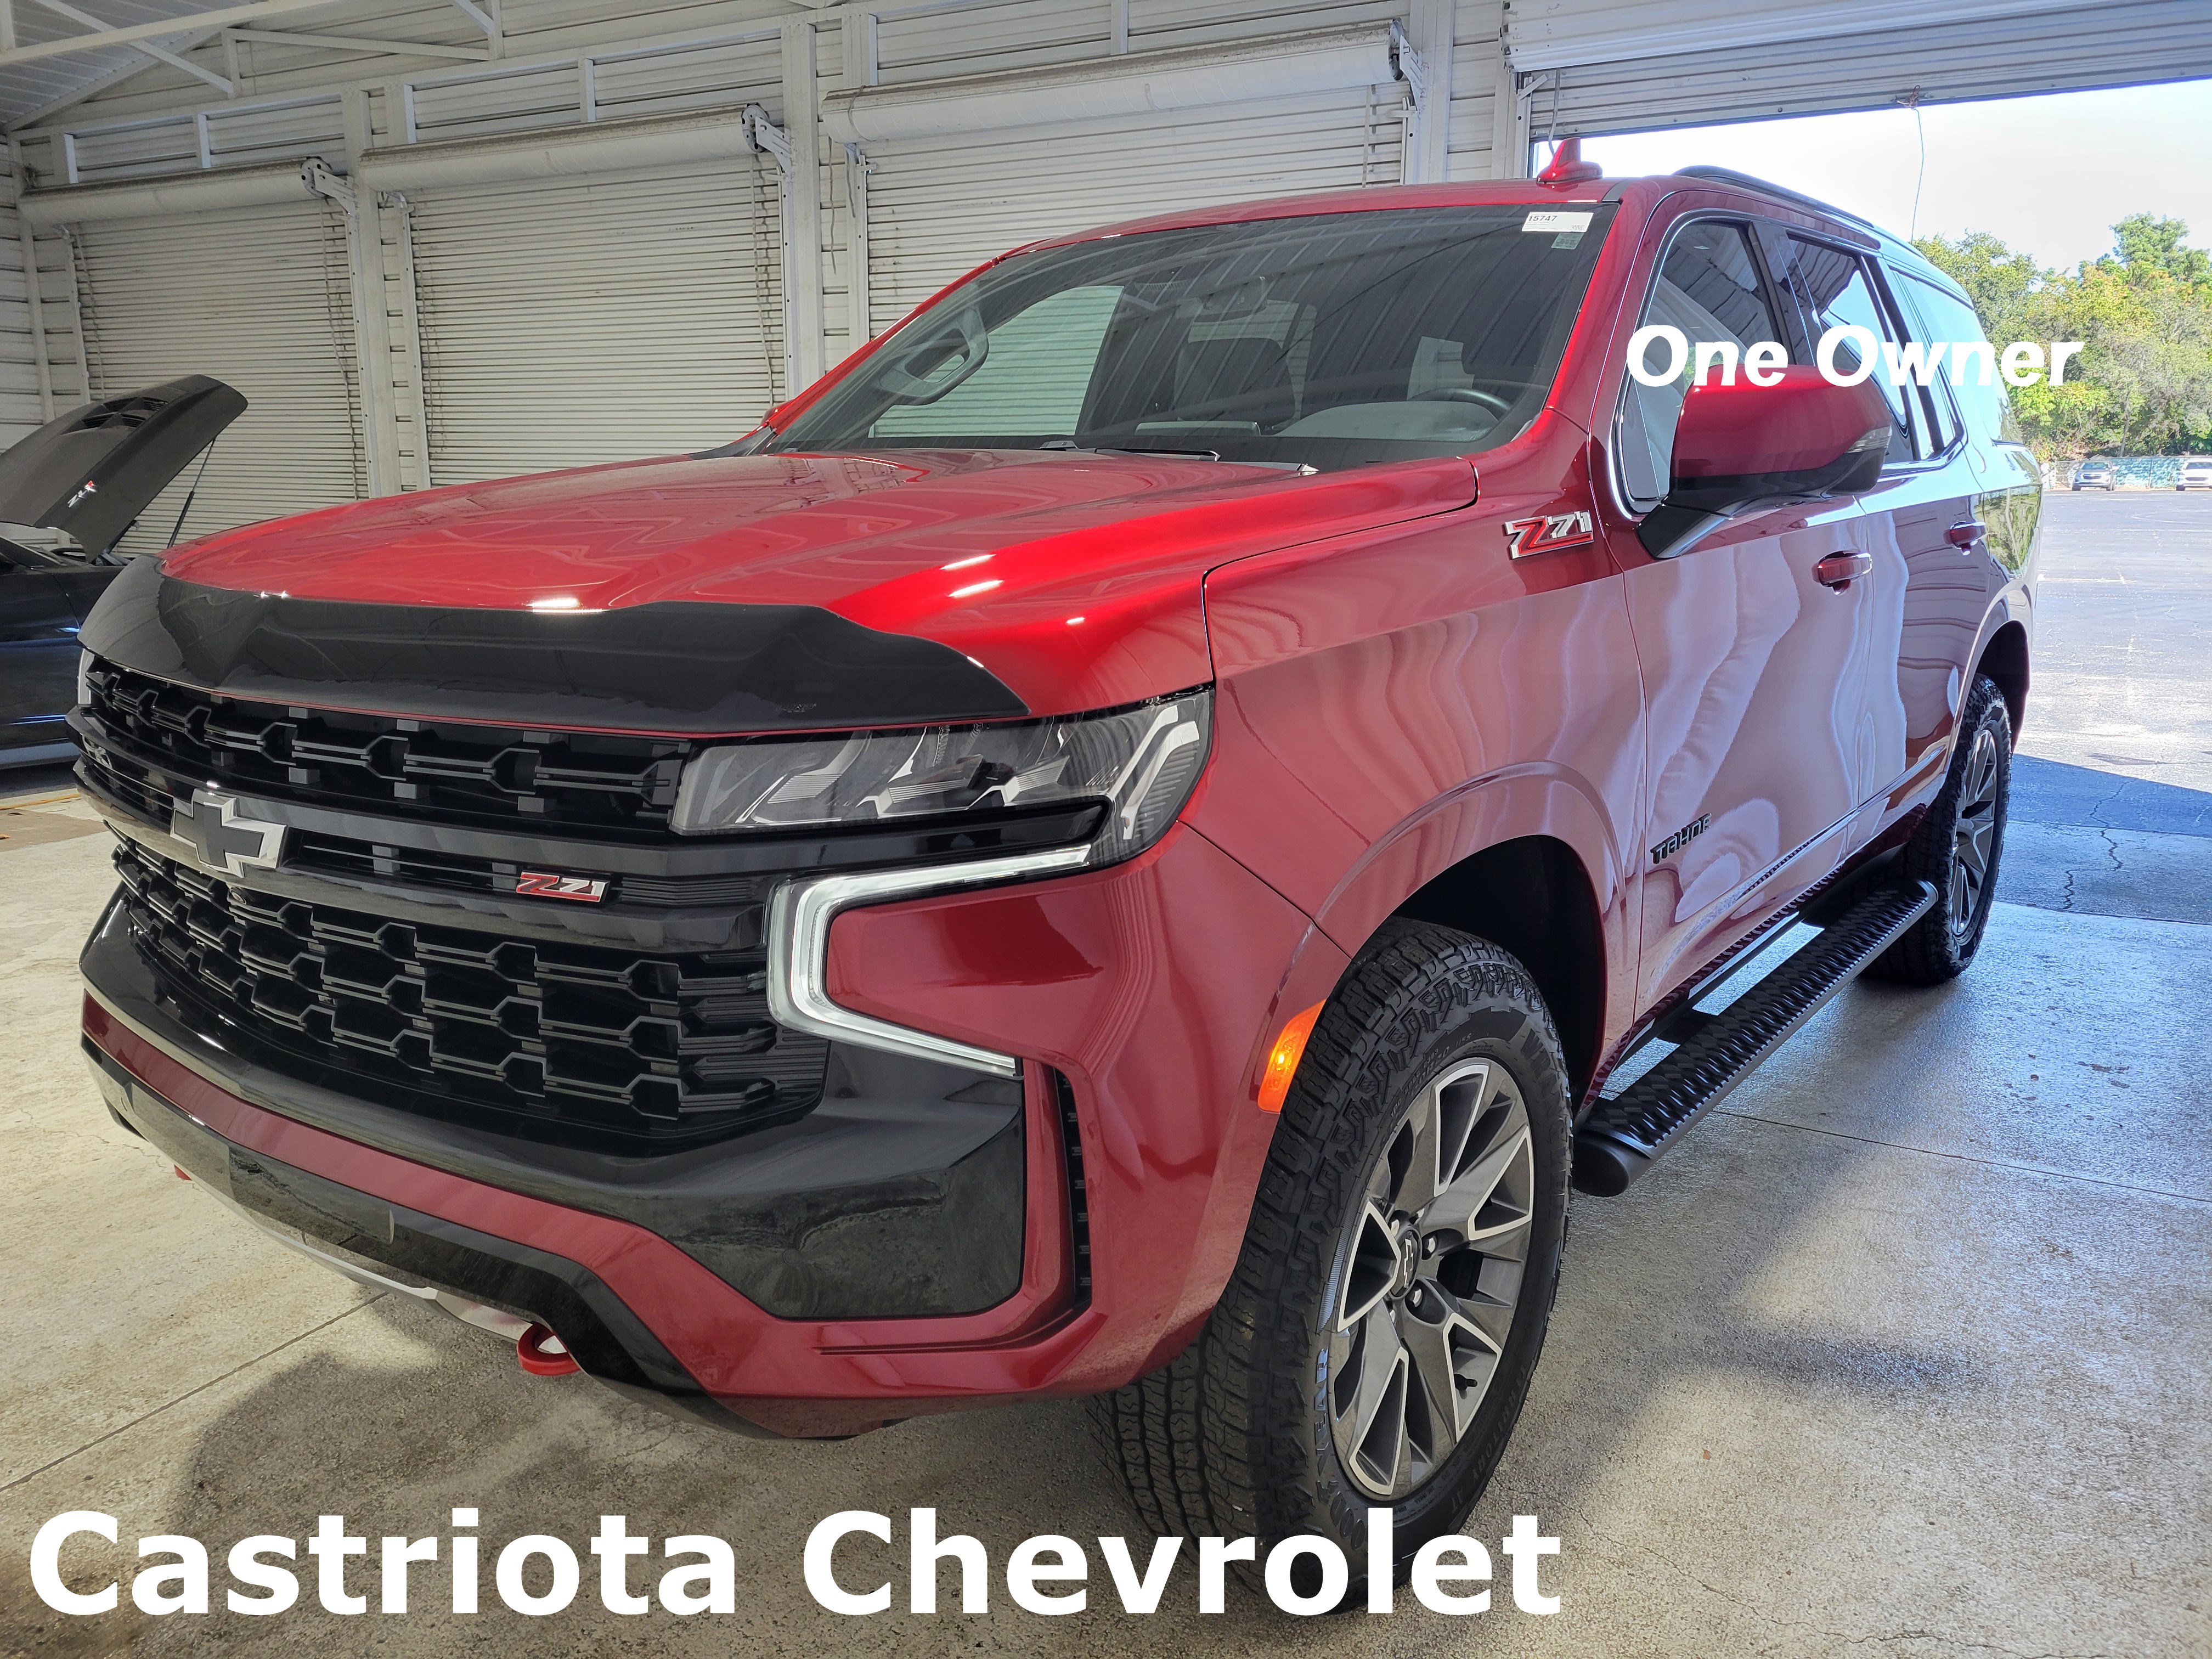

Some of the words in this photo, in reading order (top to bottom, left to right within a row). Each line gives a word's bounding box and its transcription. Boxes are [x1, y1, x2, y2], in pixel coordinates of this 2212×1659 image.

[1504, 510, 1594, 560] Z71
[1650, 812, 1712, 865] TAHOE
[516, 871, 610, 903] Z71
